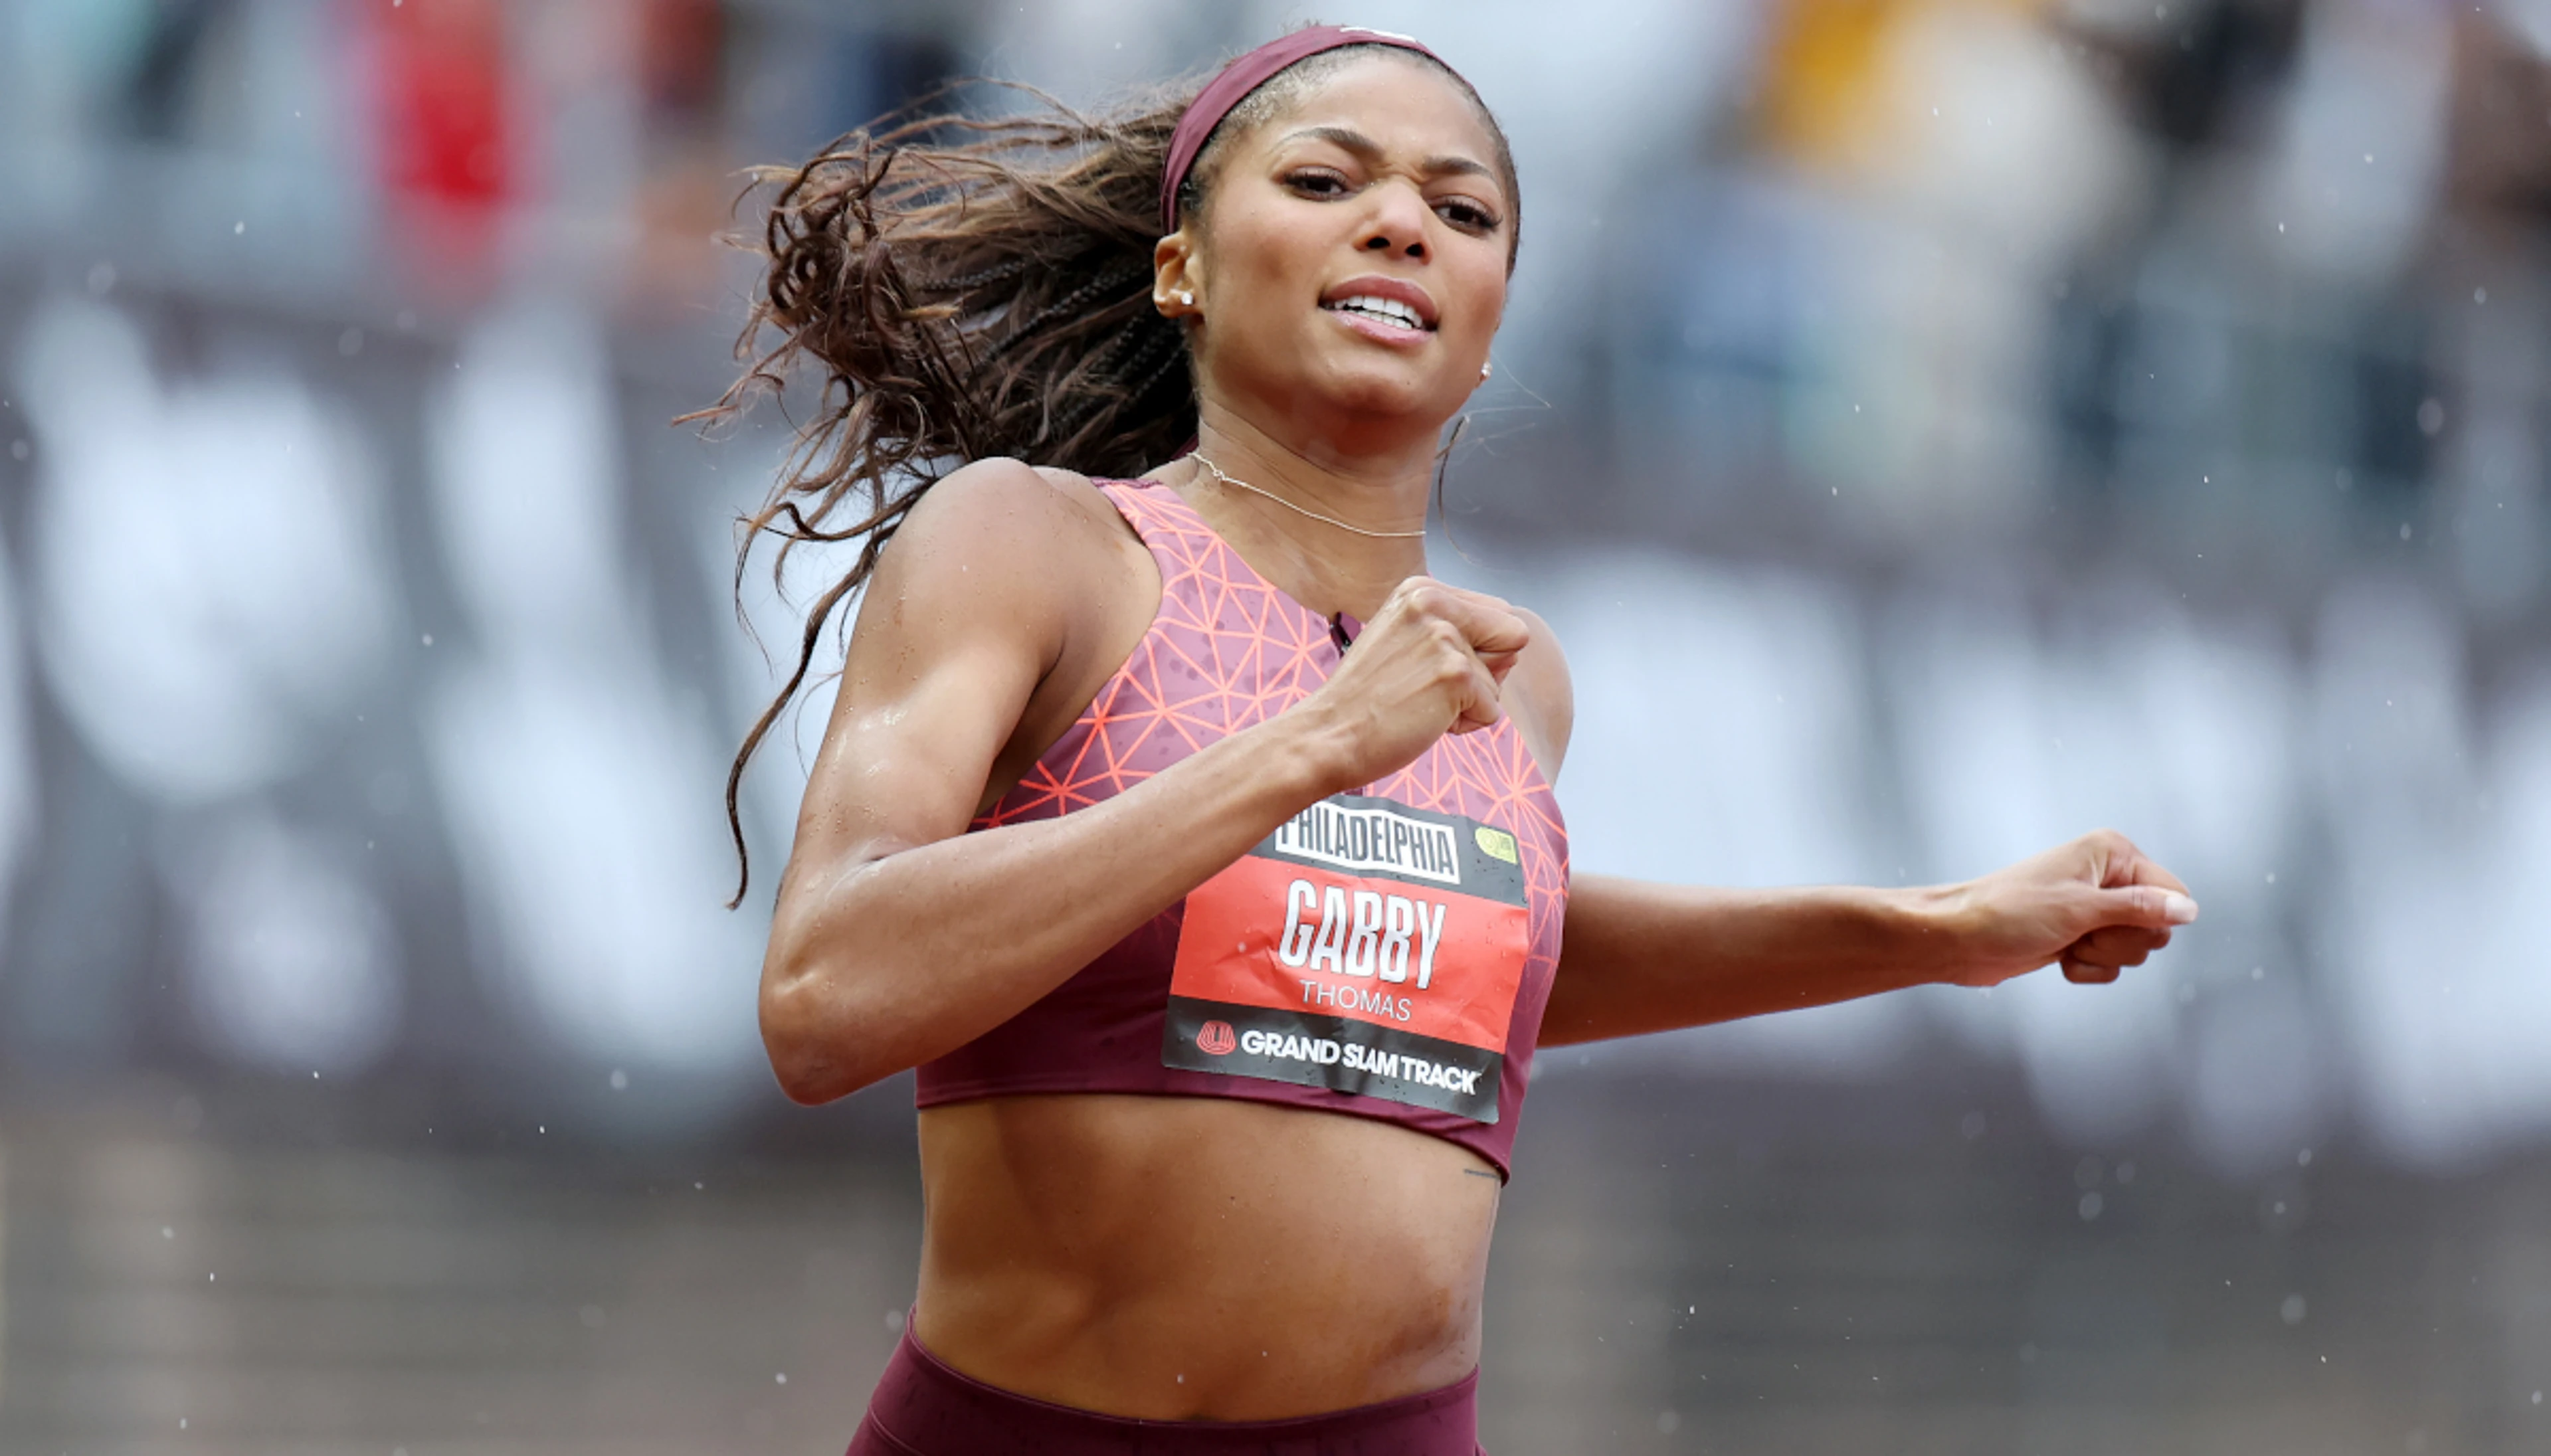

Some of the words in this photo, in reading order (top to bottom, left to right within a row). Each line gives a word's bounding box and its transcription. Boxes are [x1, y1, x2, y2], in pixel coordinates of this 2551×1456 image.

[1279, 879, 1448, 990] GABBY
[1299, 980, 1412, 1022] THOMAS
[1241, 1030, 1341, 1065] GRAND
[1342, 1043, 1399, 1079] SLAM
[1400, 1056, 1479, 1095] TRACK
